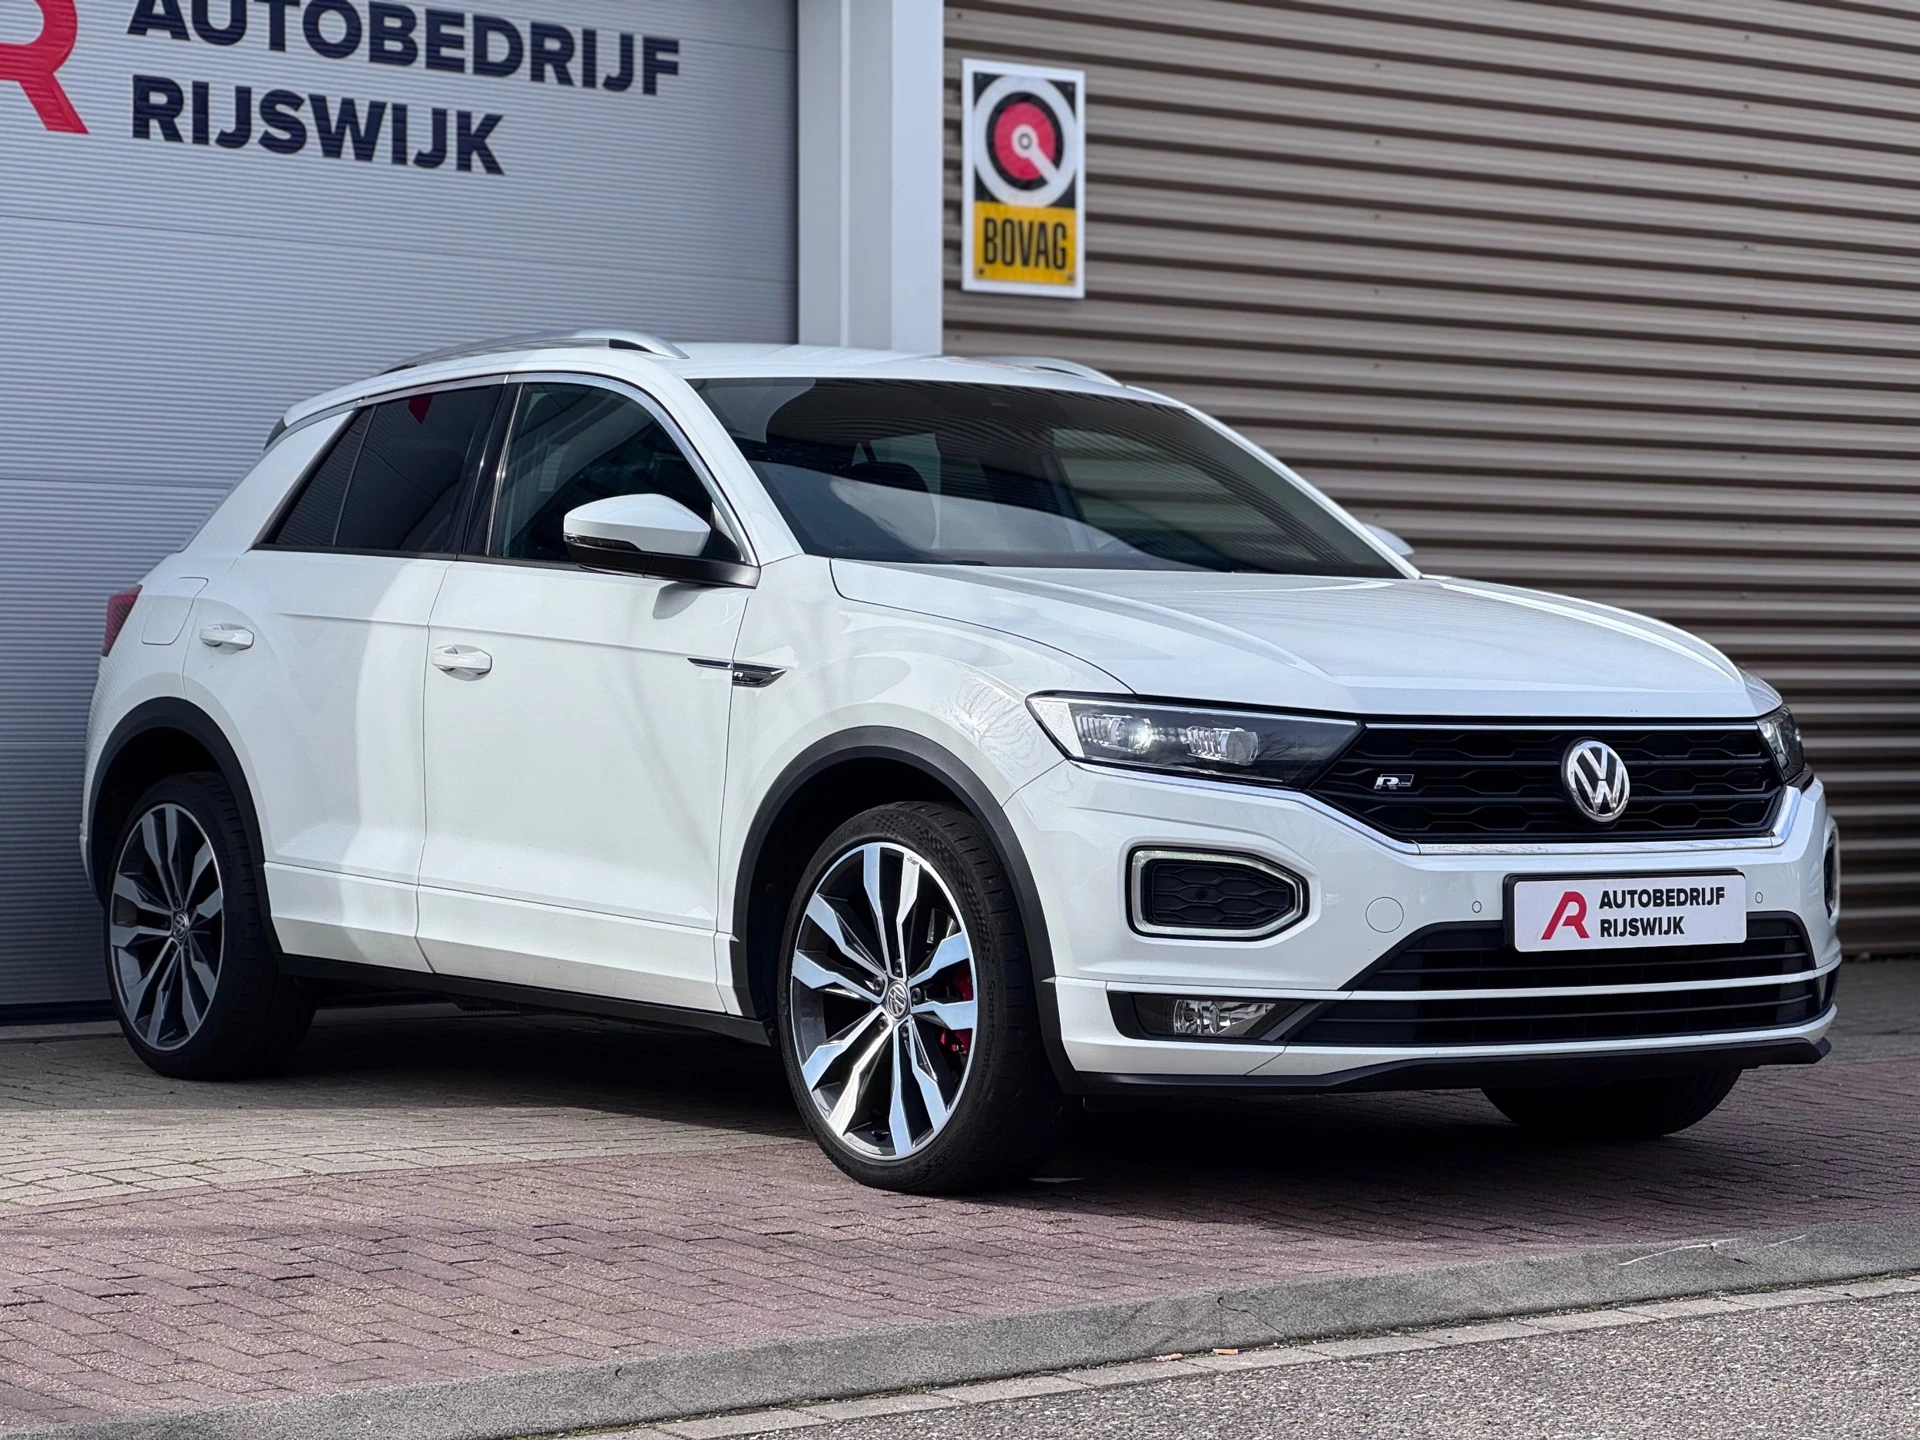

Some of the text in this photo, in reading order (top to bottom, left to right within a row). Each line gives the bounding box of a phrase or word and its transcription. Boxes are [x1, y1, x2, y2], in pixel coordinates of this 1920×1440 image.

[127, 0, 680, 96] AUTOBEDRIJF
[131, 74, 505, 175] RIJSWIJK
[983, 217, 1068, 271] BOVAG
[1599, 886, 1726, 909] AUTOBEDRIJF
[1600, 915, 1686, 938] RIJSWIJK
